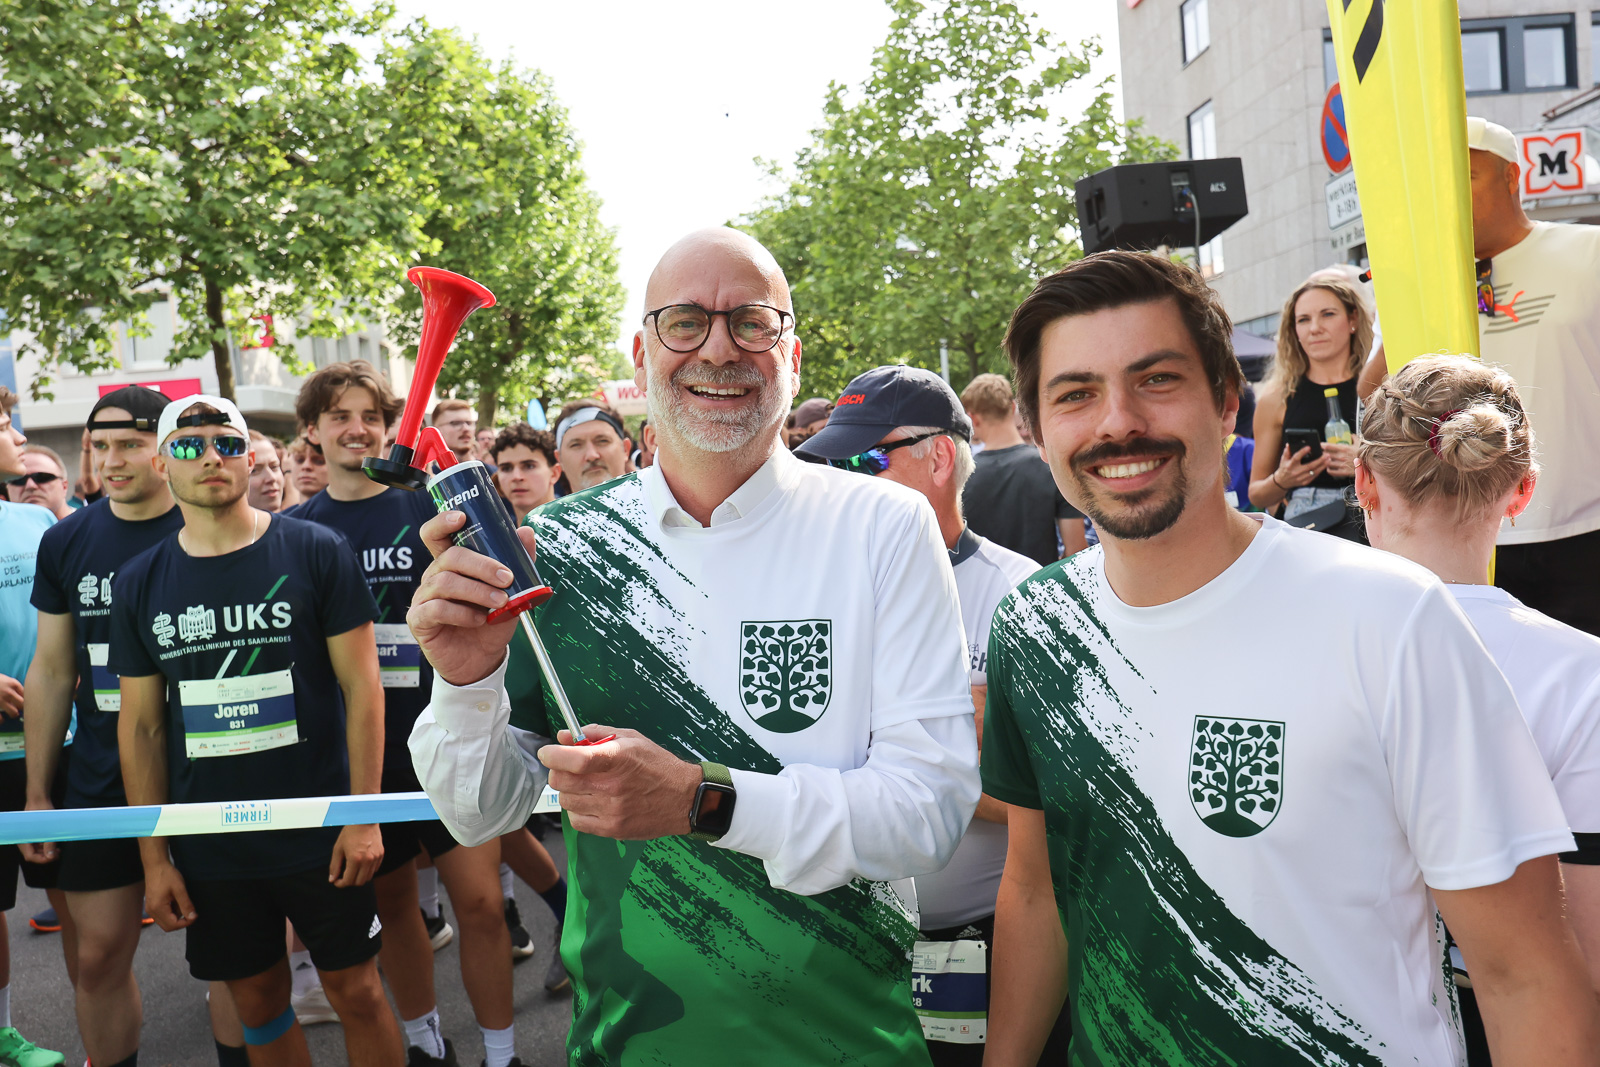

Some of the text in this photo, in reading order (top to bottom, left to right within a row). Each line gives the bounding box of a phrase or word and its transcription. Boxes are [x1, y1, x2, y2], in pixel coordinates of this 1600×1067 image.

[1539, 150, 1568, 177] M
[0, 551, 37, 564] ATIONSZ
[363, 546, 413, 572] UKS
[4, 565, 21, 576] DES
[0, 576, 34, 589] ARLAND
[79, 607, 111, 618] UNIVERSITÄT
[223, 601, 292, 633] UKS
[159, 635, 292, 661] UNIVERSITÄTSKLINIKUM DES SAARLANDES
[970, 652, 987, 673] ch
[214, 703, 259, 719] Joren
[229, 719, 246, 729] 831
[225, 810, 268, 823] FIRMEN
[912, 974, 933, 993] rk
